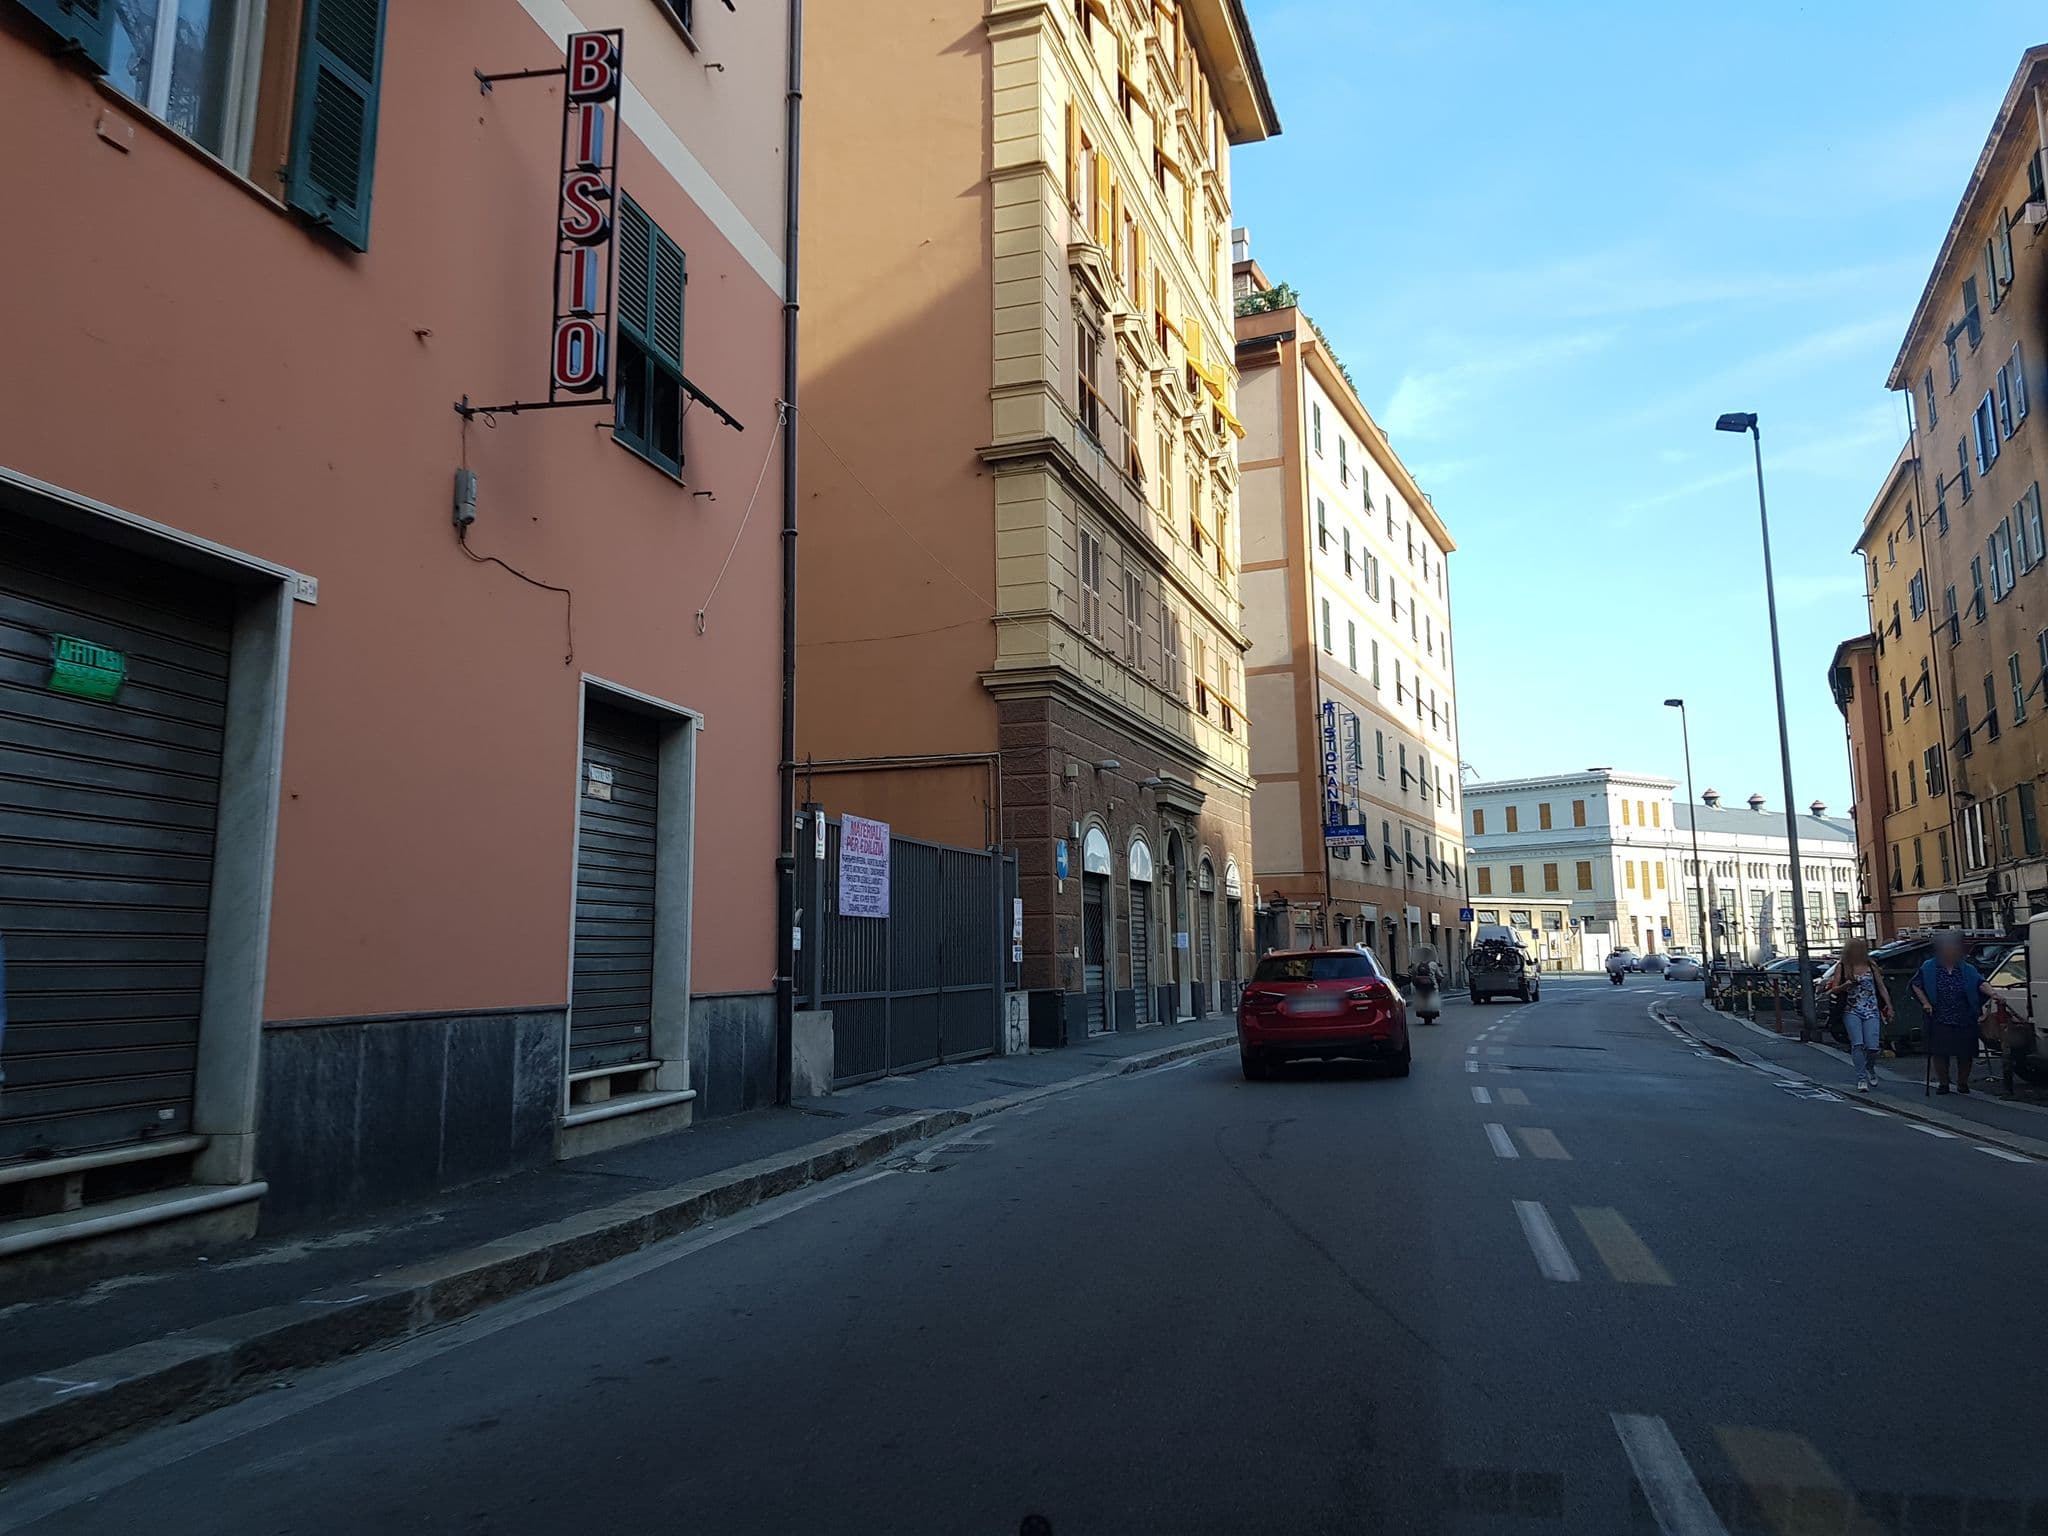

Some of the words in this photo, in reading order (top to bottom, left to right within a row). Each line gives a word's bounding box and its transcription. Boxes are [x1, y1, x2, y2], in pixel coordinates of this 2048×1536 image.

[554, 32, 611, 388] BISIO
[1323, 703, 1338, 826] RISTORANTE
[1344, 713, 1359, 809] PIZZERIA
[847, 835, 859, 852] PER
[860, 839, 884, 857] EDILIZIA
[850, 820, 882, 841] MATERIALI
